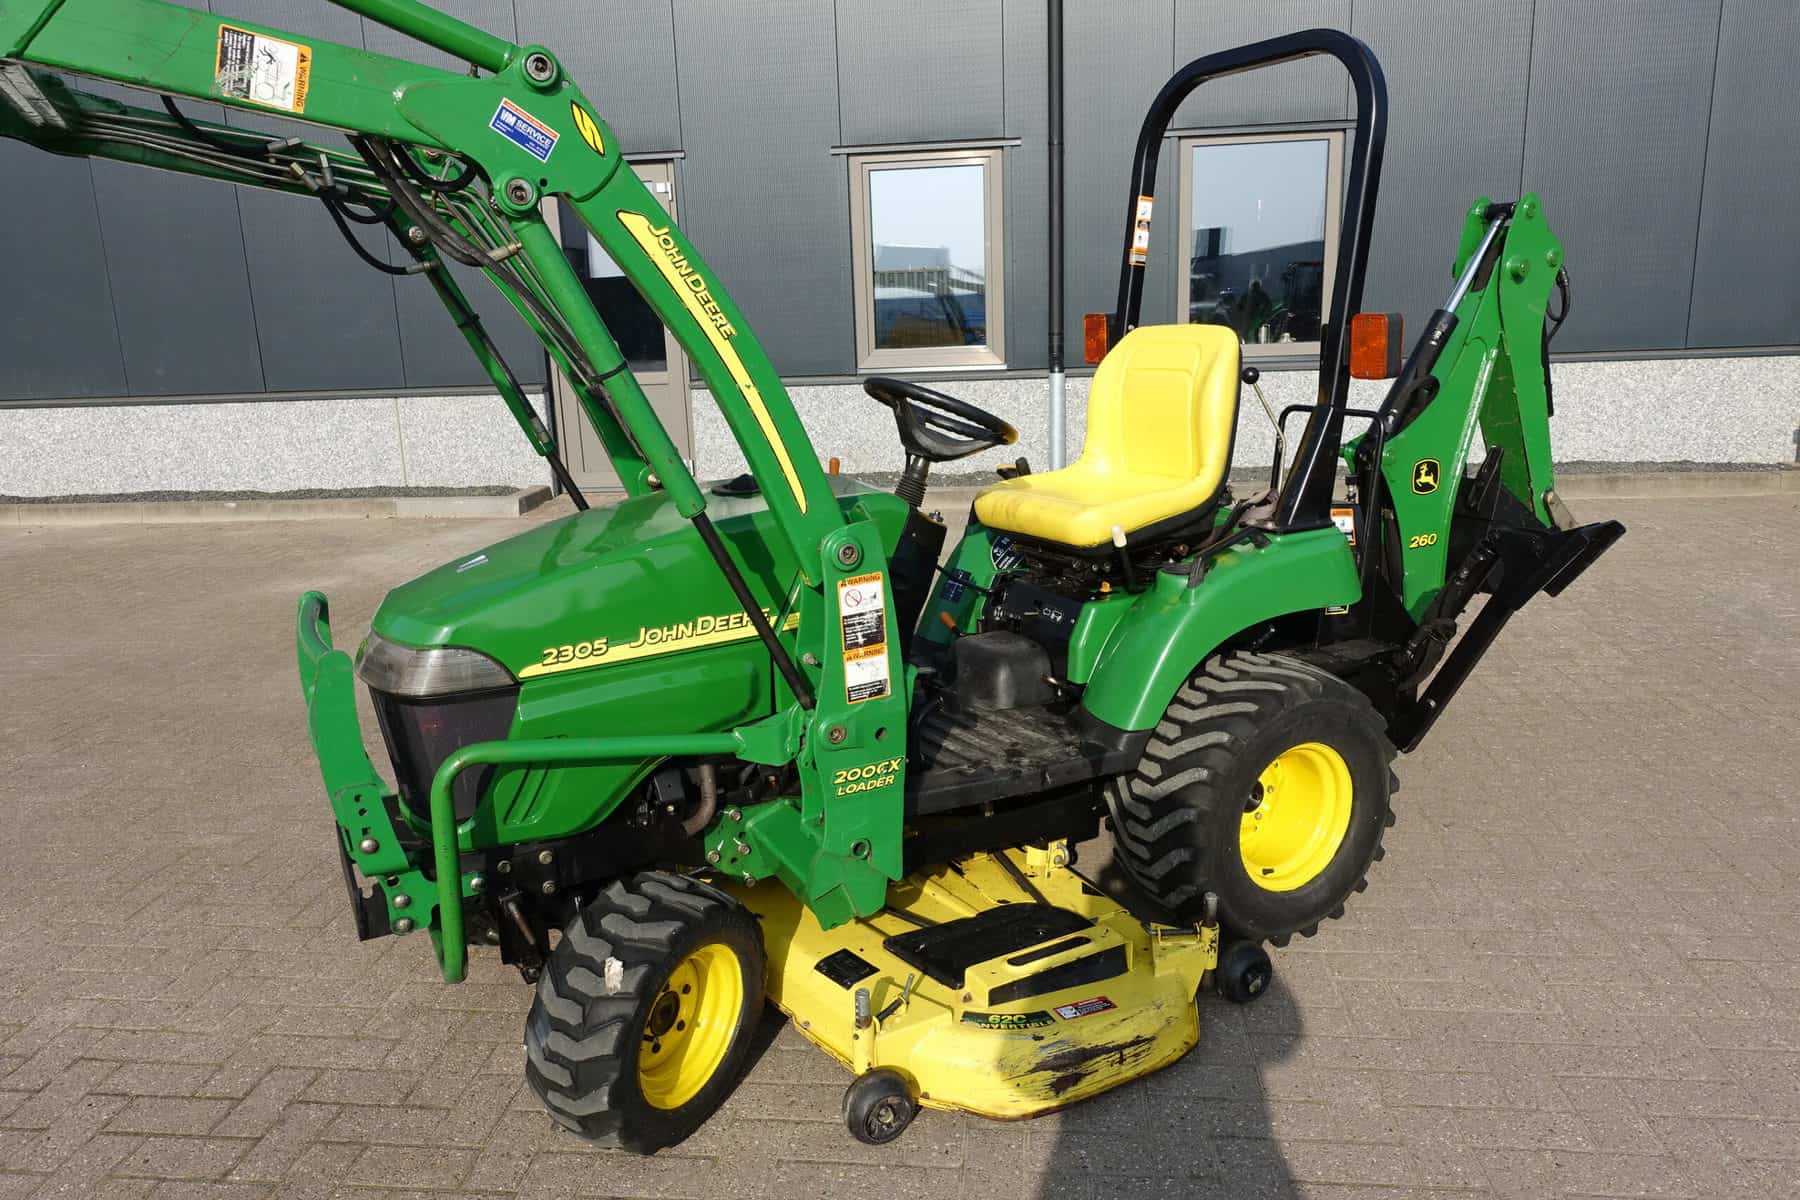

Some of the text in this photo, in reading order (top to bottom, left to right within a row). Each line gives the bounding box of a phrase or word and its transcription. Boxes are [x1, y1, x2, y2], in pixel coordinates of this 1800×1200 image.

[516, 119, 553, 146] SERVICE
[648, 225, 738, 340] JOHN DEERE
[1409, 533, 1438, 549] 260
[848, 574, 881, 586] WARNING
[542, 637, 608, 666] 2305
[629, 620, 697, 648] JOHN
[836, 774, 896, 797] LOADER
[989, 1014, 1028, 1025] 62C
